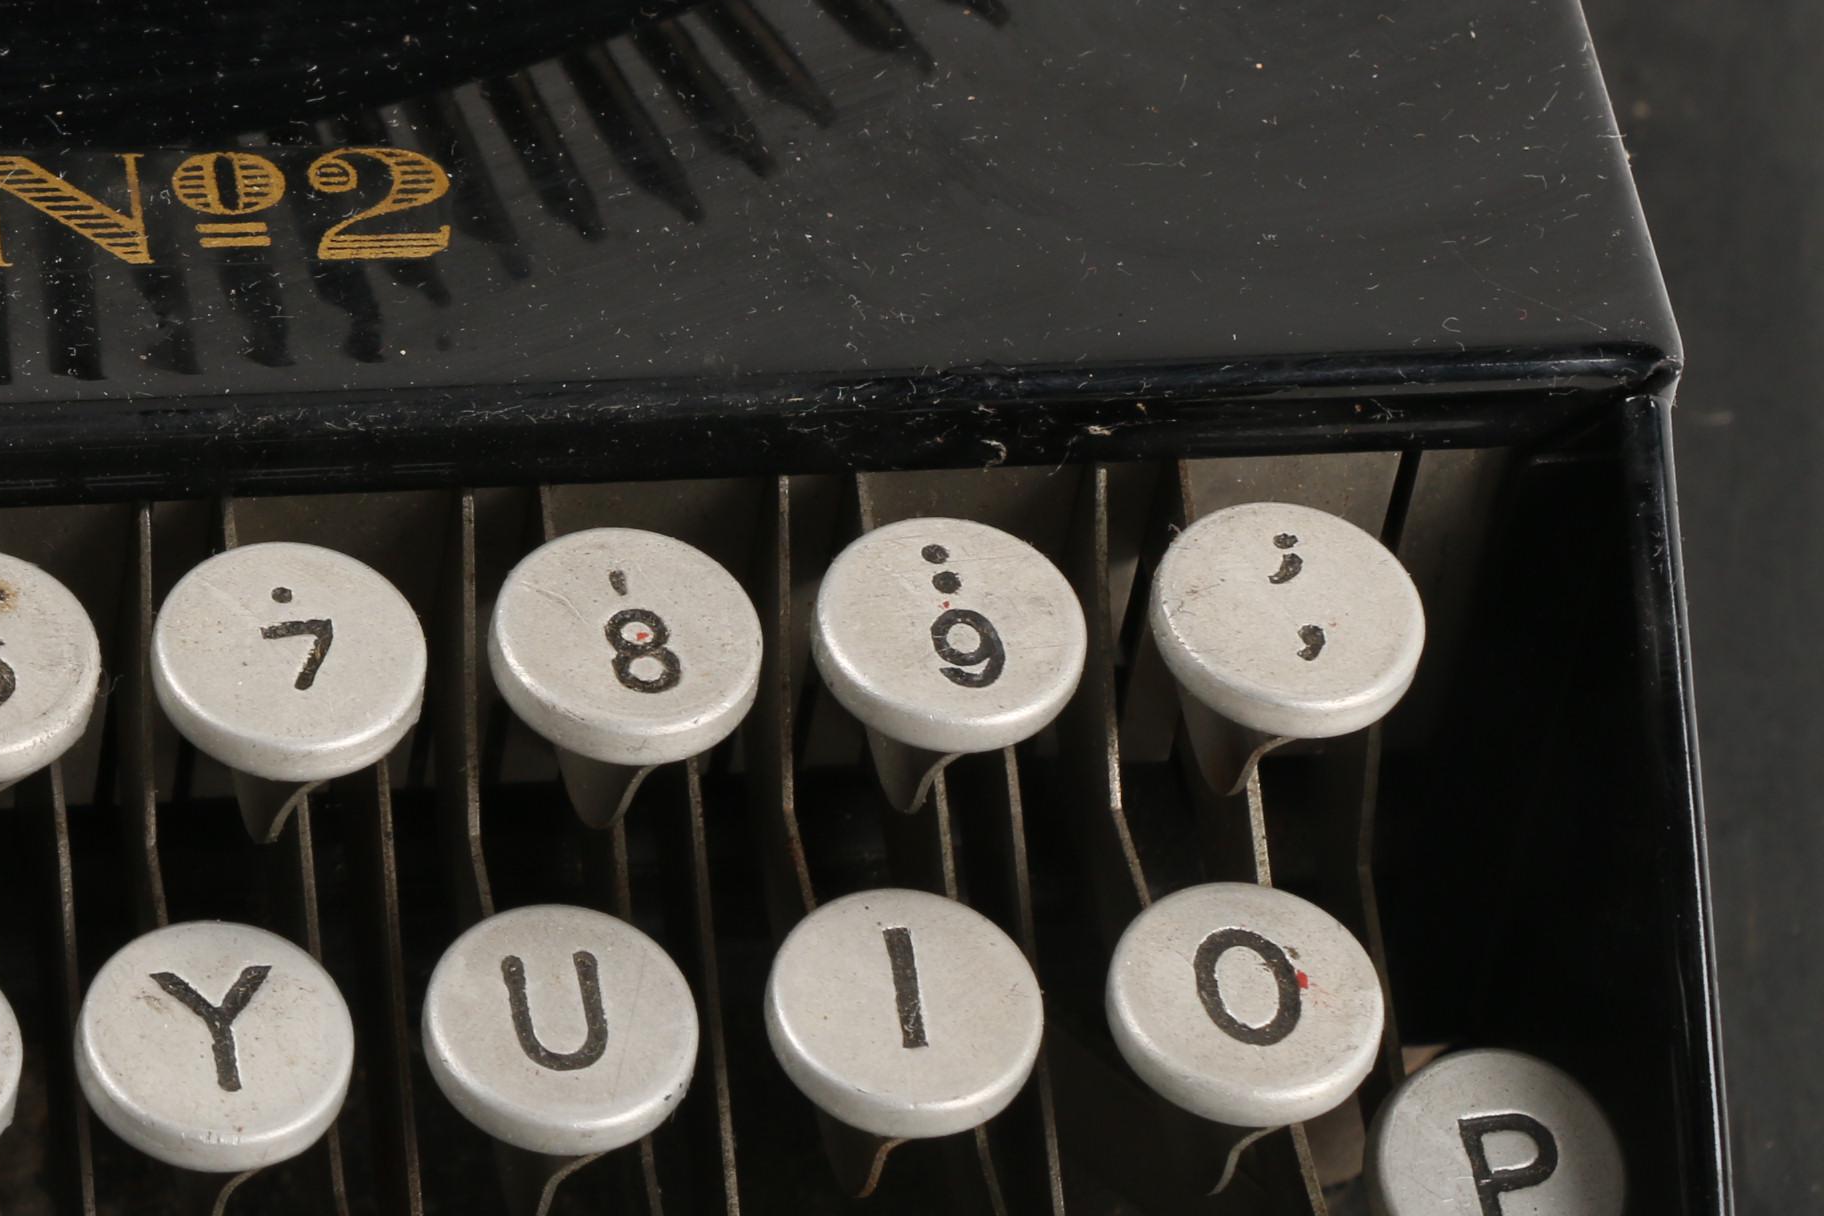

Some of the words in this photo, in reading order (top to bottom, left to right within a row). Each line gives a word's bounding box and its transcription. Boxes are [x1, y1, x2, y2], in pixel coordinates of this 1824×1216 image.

[922, 544, 961, 594] :
[261, 619, 333, 690] 7
[604, 609, 681, 694] 8
[931, 609, 1005, 688] 9
[149, 966, 272, 1092] Y
[501, 951, 608, 1071] U
[883, 928, 928, 1049] I
[1194, 928, 1303, 1046] O
[1458, 1111, 1559, 1216] P
